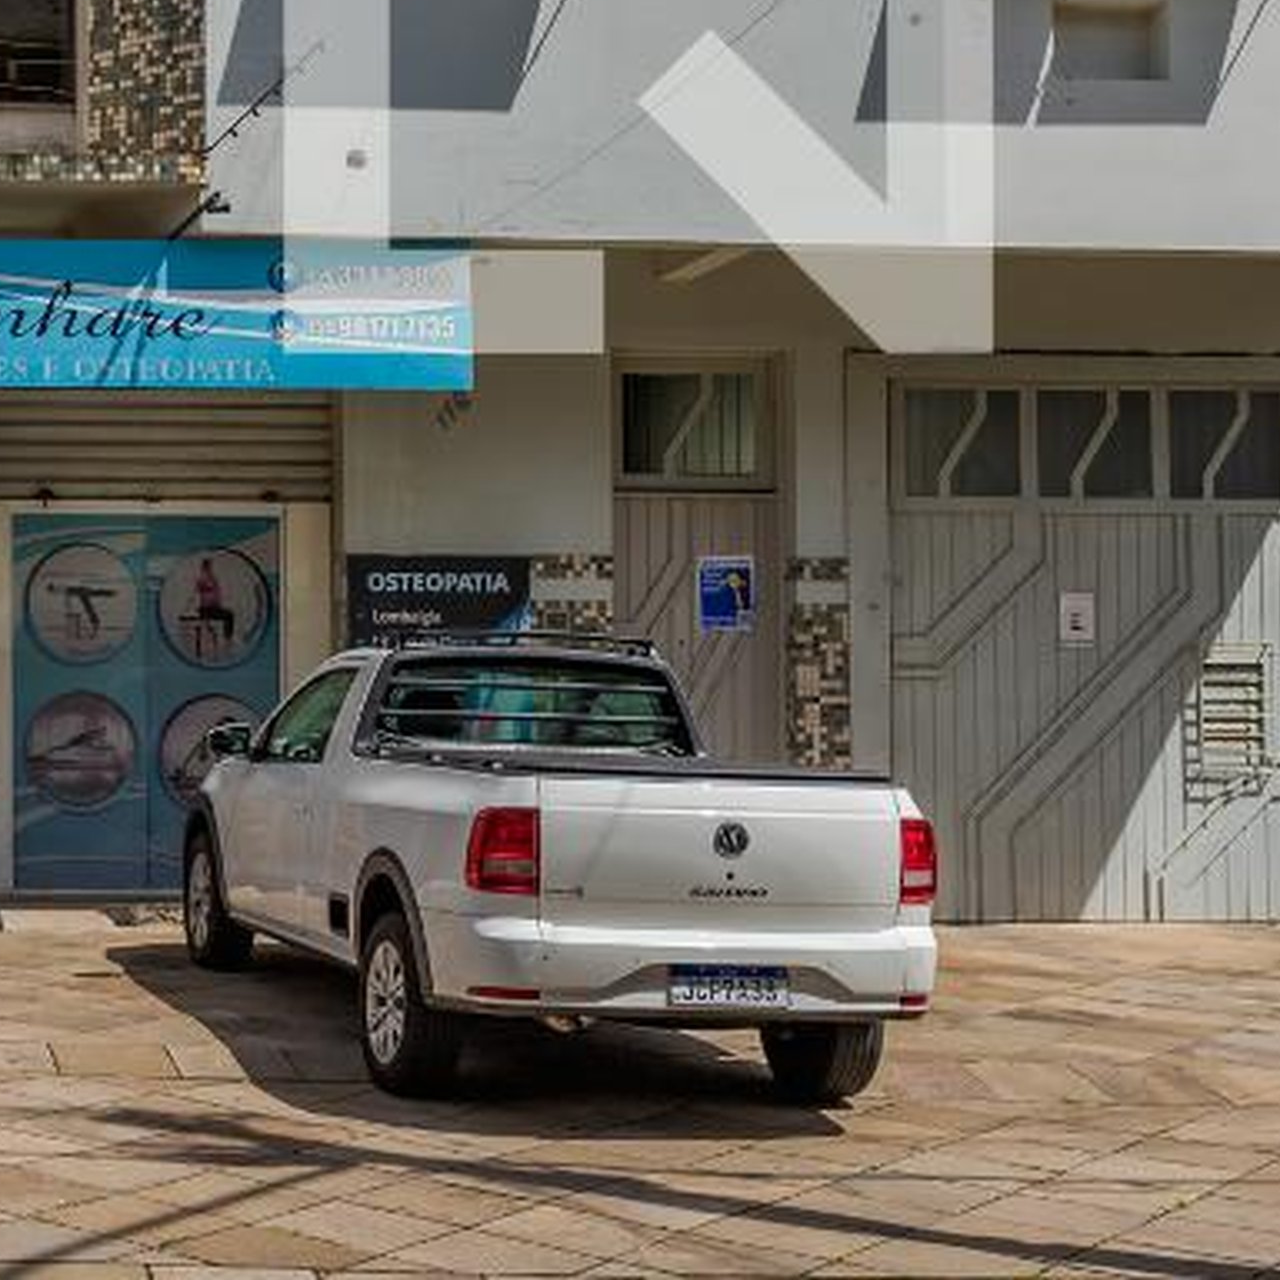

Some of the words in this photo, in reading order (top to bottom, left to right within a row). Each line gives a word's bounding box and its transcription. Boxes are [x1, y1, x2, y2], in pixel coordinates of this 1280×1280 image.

[43, 356, 63, 382] E
[74, 357, 276, 385] OSTEOPATIA
[366, 571, 511, 594] OSTEOPATIA
